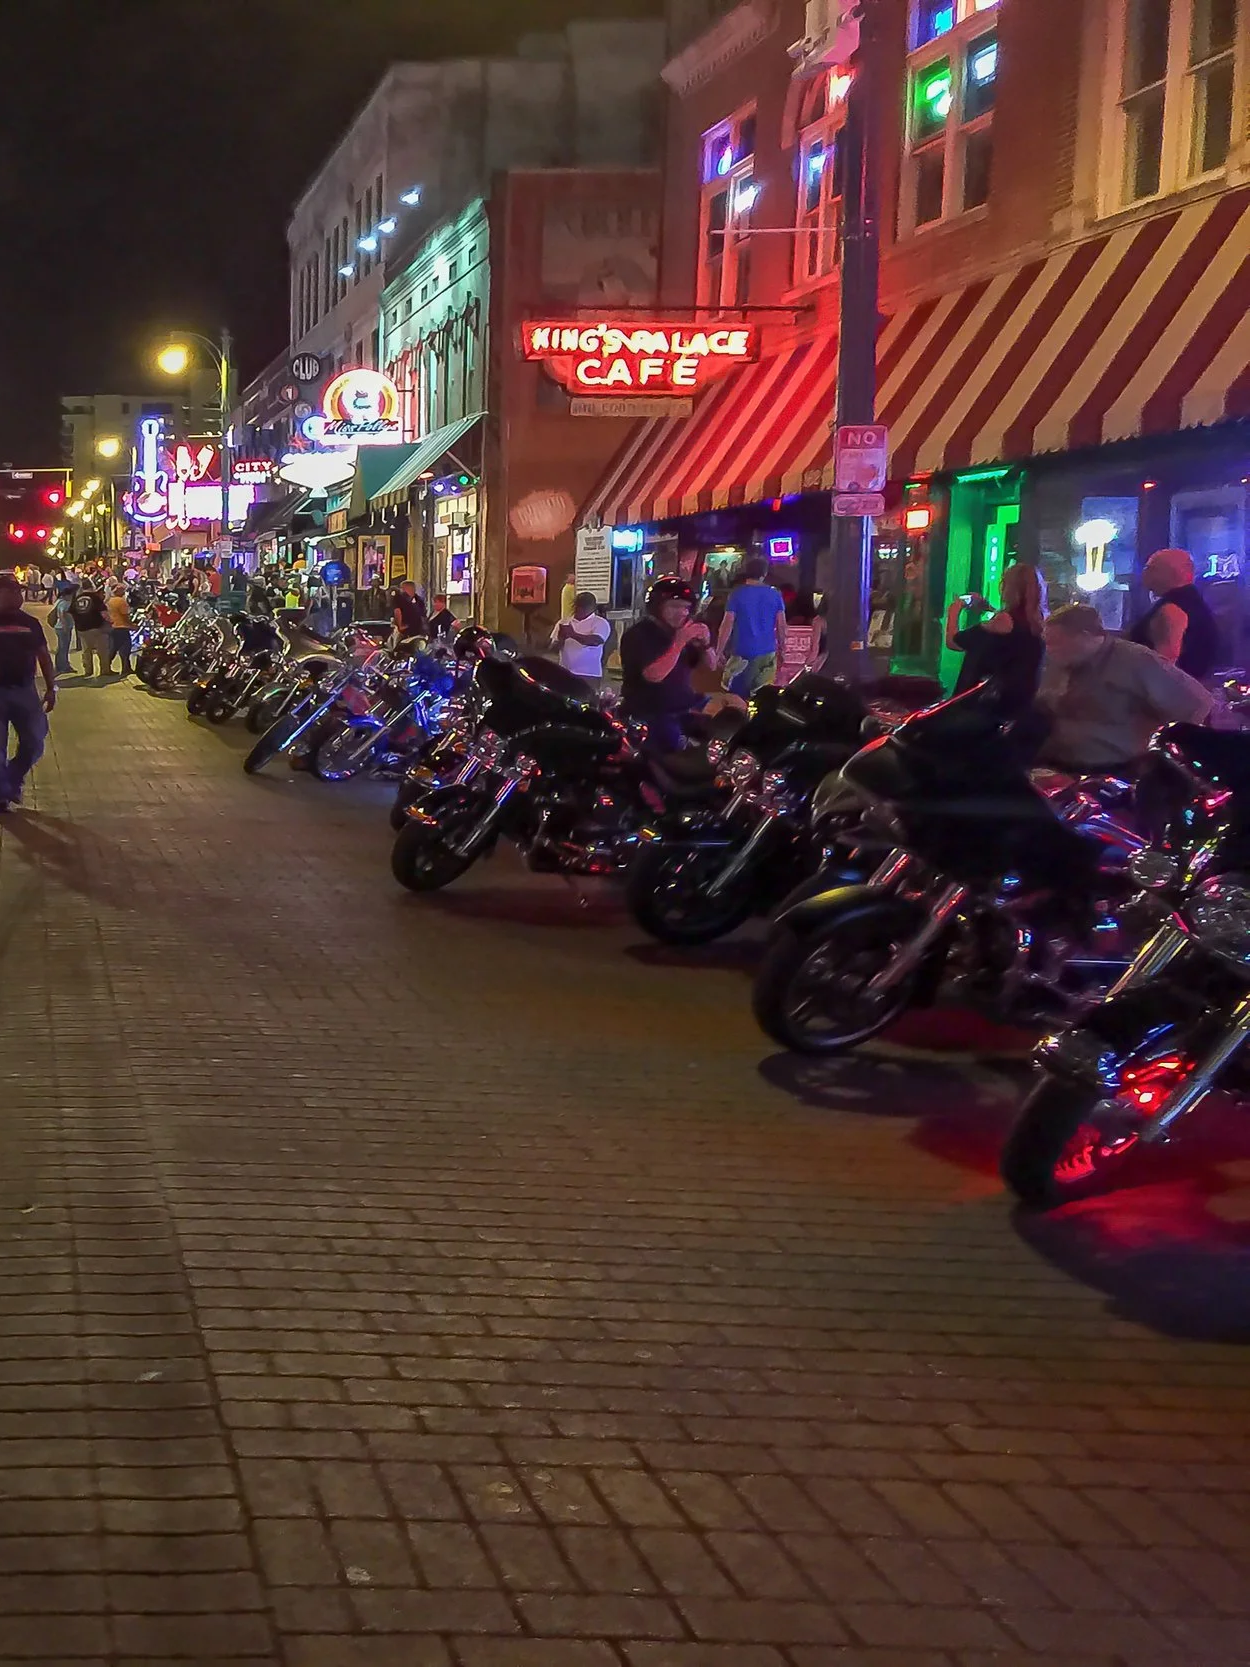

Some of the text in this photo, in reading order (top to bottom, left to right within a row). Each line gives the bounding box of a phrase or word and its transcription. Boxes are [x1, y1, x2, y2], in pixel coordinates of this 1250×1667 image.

[292, 357, 319, 380] CLUB
[847, 431, 877, 445] NO
[234, 461, 272, 472] CITY
